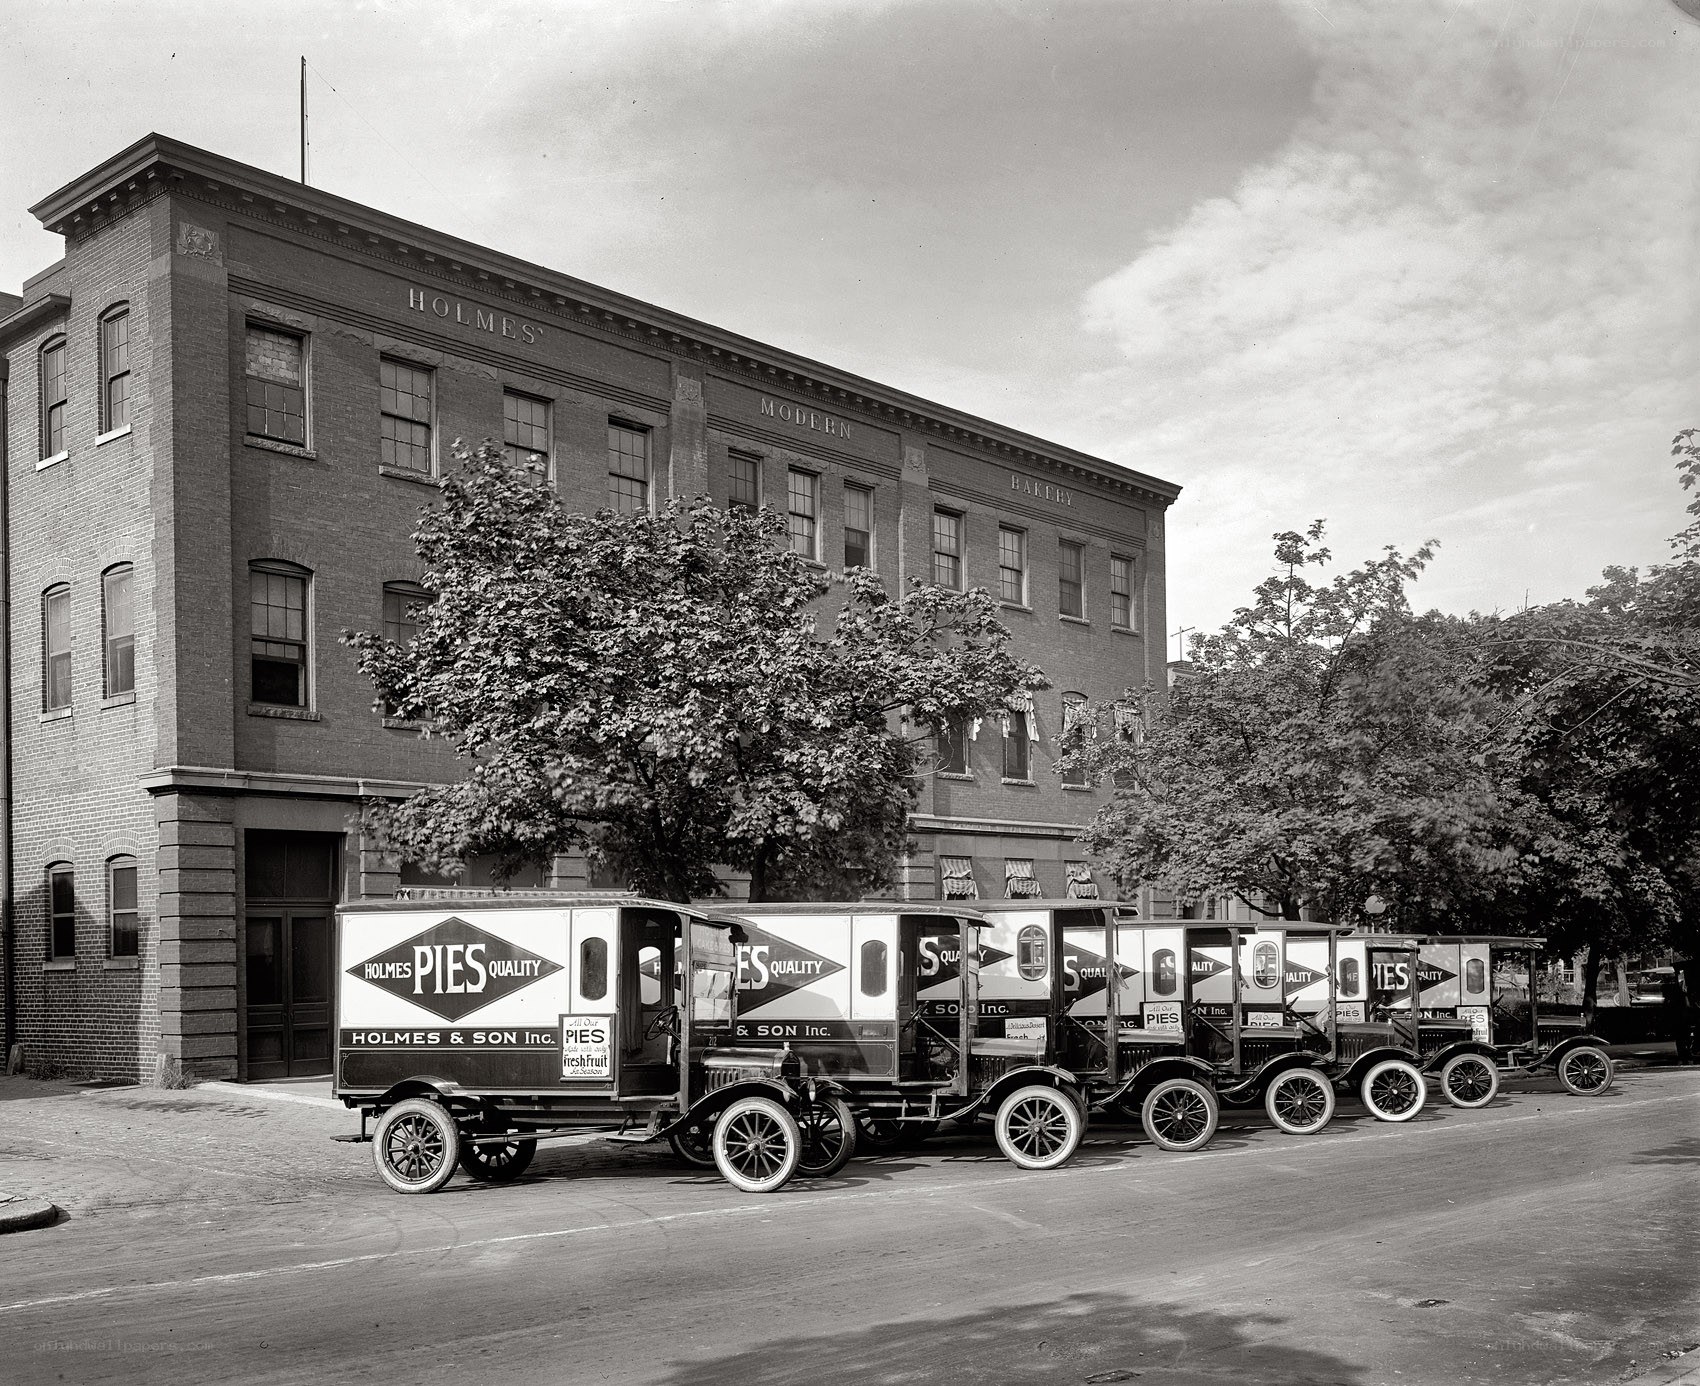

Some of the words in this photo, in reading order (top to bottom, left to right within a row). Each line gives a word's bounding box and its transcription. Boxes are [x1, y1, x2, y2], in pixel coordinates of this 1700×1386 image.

[761, 397, 851, 440] MODERN
[1011, 474, 1073, 506] BAKERY
[940, 950, 987, 966] QUAY
[364, 962, 412, 980] HOLMES
[412, 943, 487, 995] PIES
[488, 959, 542, 978] QUALITY
[738, 945, 770, 990] ES
[770, 961, 823, 976] QUALITY
[1192, 961, 1214, 972] ALITY
[1285, 971, 1312, 983] ALITY
[1373, 963, 1409, 990] IES
[935, 1004, 959, 1014] SO
[981, 1003, 1009, 1014] Inc.
[1211, 1006, 1228, 1015] Inc.
[1147, 1012, 1179, 1024] PIES
[1436, 1011, 1453, 1019] Inc.
[569, 1018, 582, 1027] All
[583, 1018, 599, 1027] Our
[1120, 1020, 1138, 1028] nc.
[565, 1029, 605, 1044] PIES
[736, 1025, 749, 1037] &
[757, 1025, 796, 1036] SON
[805, 1025, 831, 1036] Inc.
[352, 1032, 441, 1045] HOLMES
[449, 1032, 465, 1045] &
[472, 1032, 517, 1044] SON
[524, 1031, 556, 1045] Inc.
